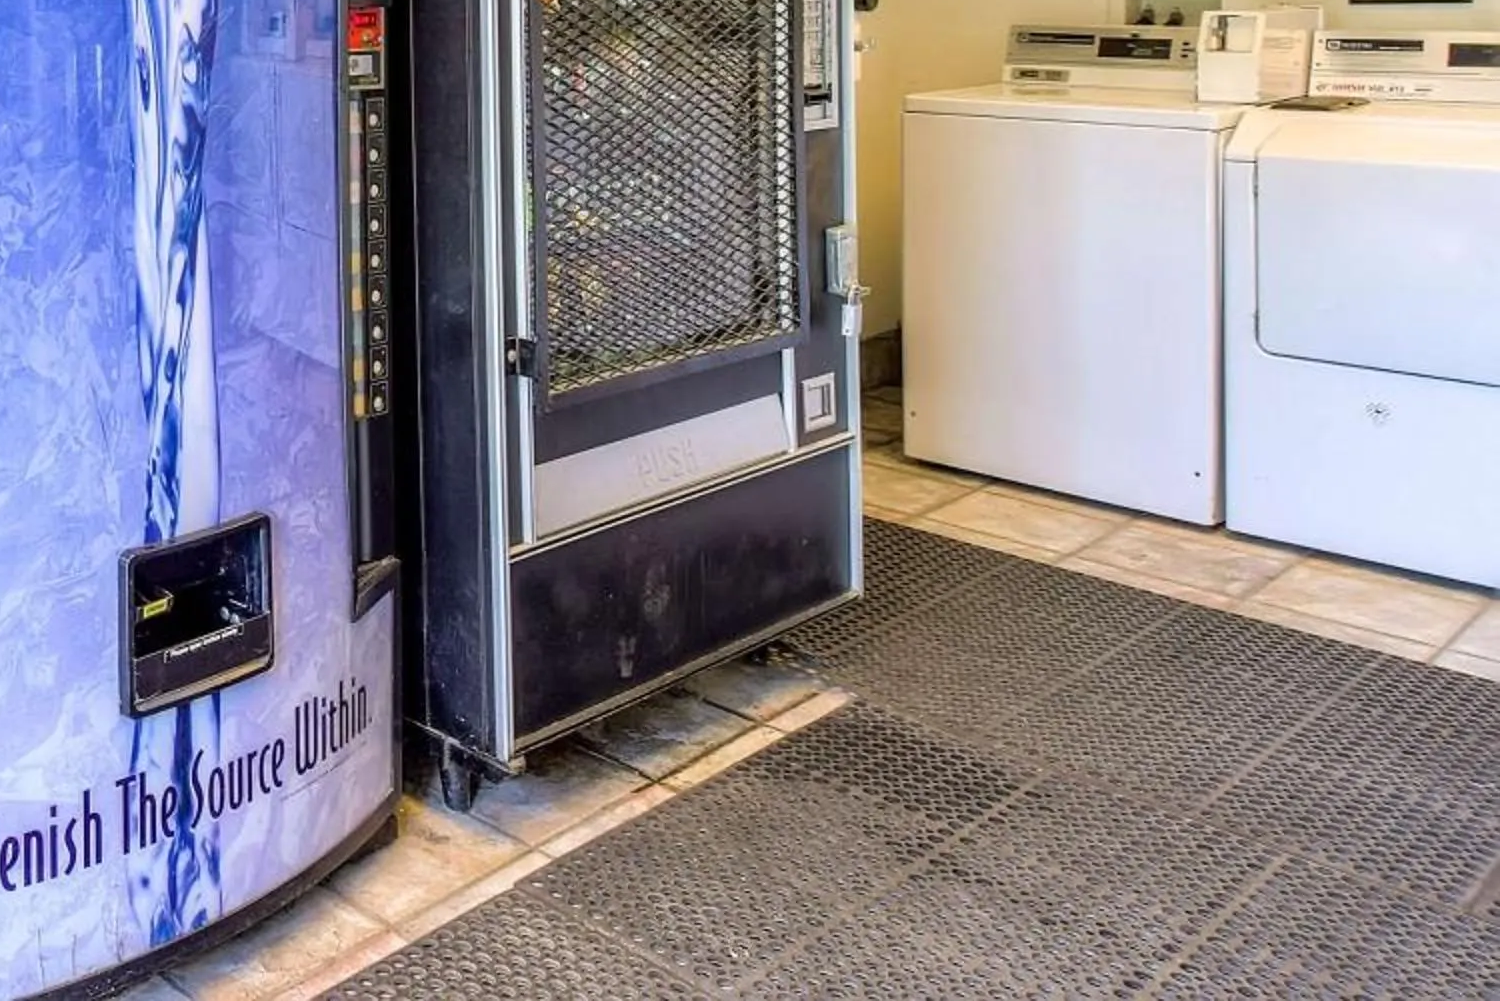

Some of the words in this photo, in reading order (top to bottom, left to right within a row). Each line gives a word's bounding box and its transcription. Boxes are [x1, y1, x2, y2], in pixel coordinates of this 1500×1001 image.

[115, 771, 176, 856] The
[190, 737, 286, 830] Source
[293, 677, 374, 777] Within.
